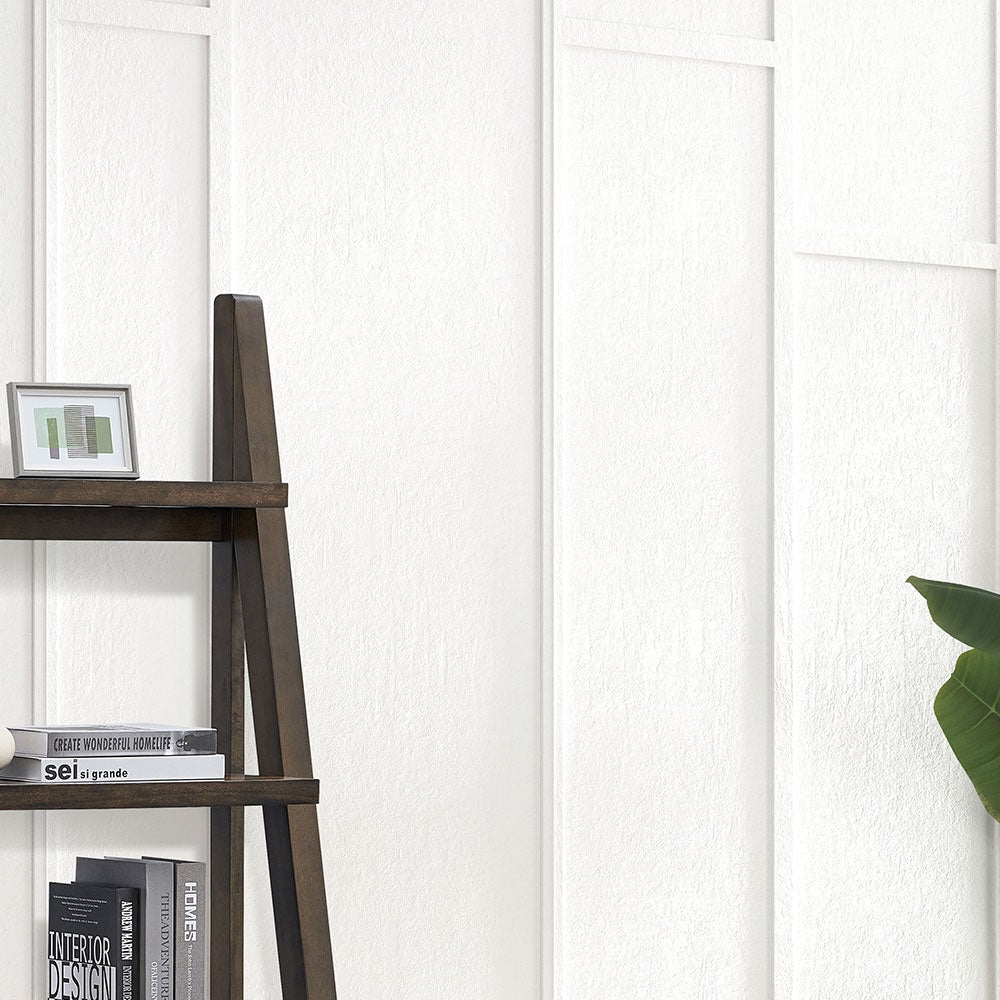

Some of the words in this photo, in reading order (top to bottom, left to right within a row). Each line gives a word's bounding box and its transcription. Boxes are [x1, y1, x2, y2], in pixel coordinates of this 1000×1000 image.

[53, 737, 81, 752] CREATE
[83, 736, 131, 751] WONDERFUL
[133, 736, 171, 751] HOMELIFE
[44, 758, 79, 781] sei
[80, 769, 89, 779] si
[91, 768, 128, 781] grande
[121, 901, 133, 932] ANDREW
[184, 882, 197, 942] HOMES
[48, 931, 111, 966] INTERIOR
[121, 933, 133, 961] MARTIN
